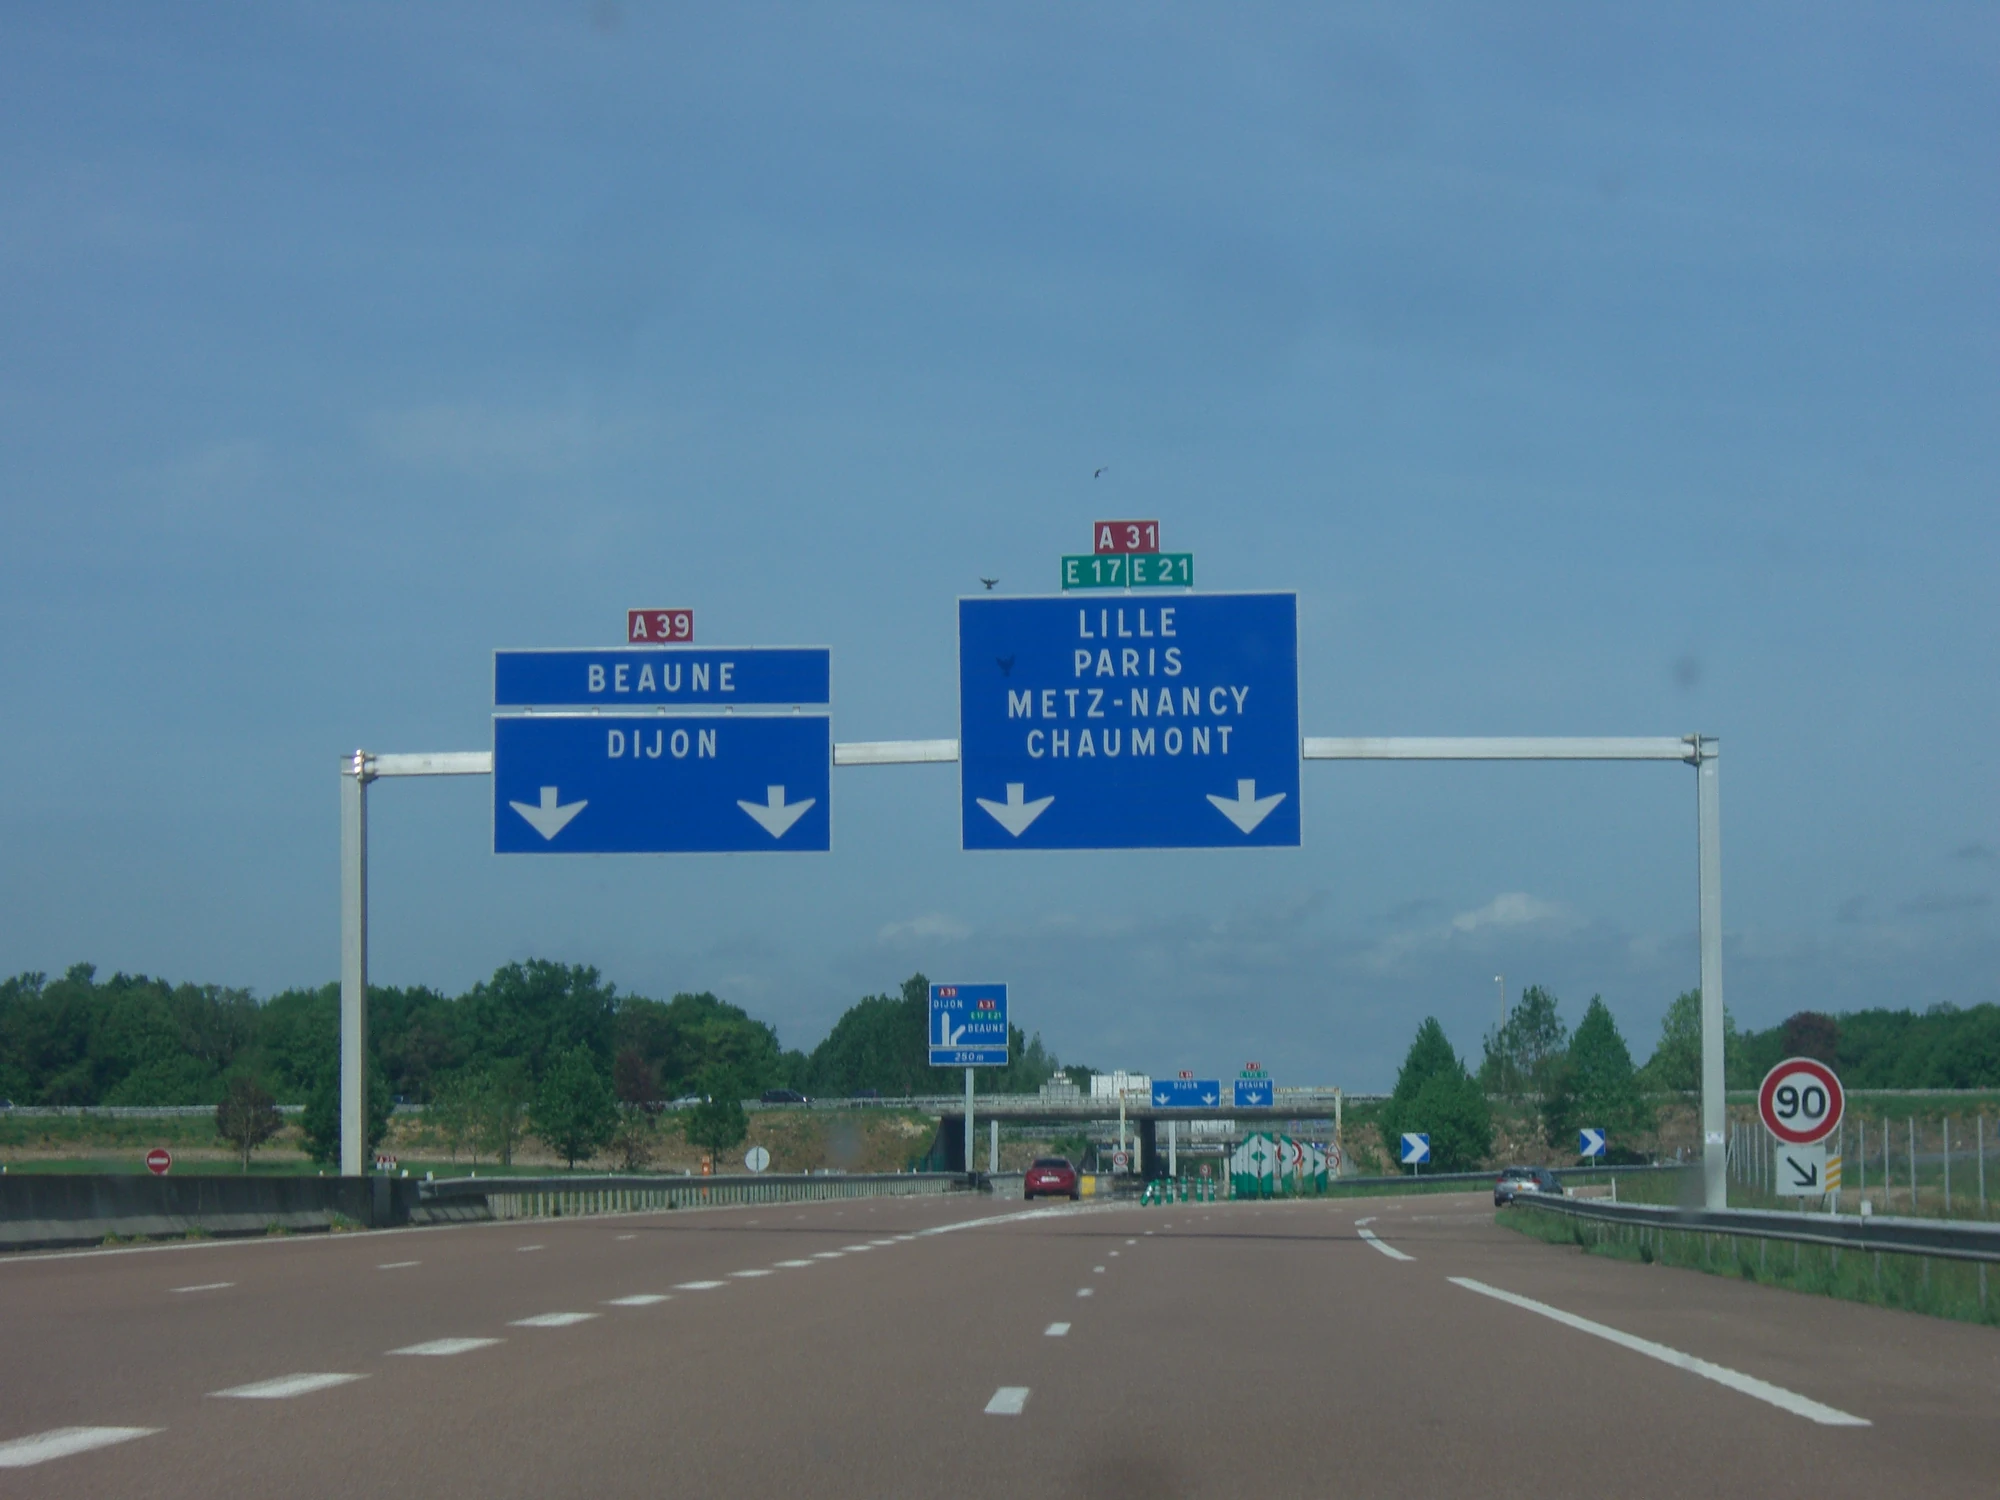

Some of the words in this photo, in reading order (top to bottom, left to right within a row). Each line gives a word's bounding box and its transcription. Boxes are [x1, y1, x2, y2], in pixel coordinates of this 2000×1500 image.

[1099, 526, 1114, 549] A
[1126, 525, 1156, 549] 31
[1066, 560, 1079, 583] E
[1092, 559, 1121, 583] 17
[1133, 558, 1146, 582] E
[1158, 557, 1188, 581] 21
[632, 615, 648, 638] A
[657, 614, 689, 638] 39
[1079, 607, 1176, 638] LILLE
[1074, 647, 1182, 677] PARIS
[588, 662, 735, 693] BEAUNE
[1008, 686, 1249, 718] METZ-NANCY
[608, 729, 717, 758] DIJON
[1027, 726, 1232, 758] CHAUMONT
[933, 999, 963, 1009] DIJON
[967, 1023, 1005, 1033] BEAUNE
[1776, 1085, 1826, 1119] 90
